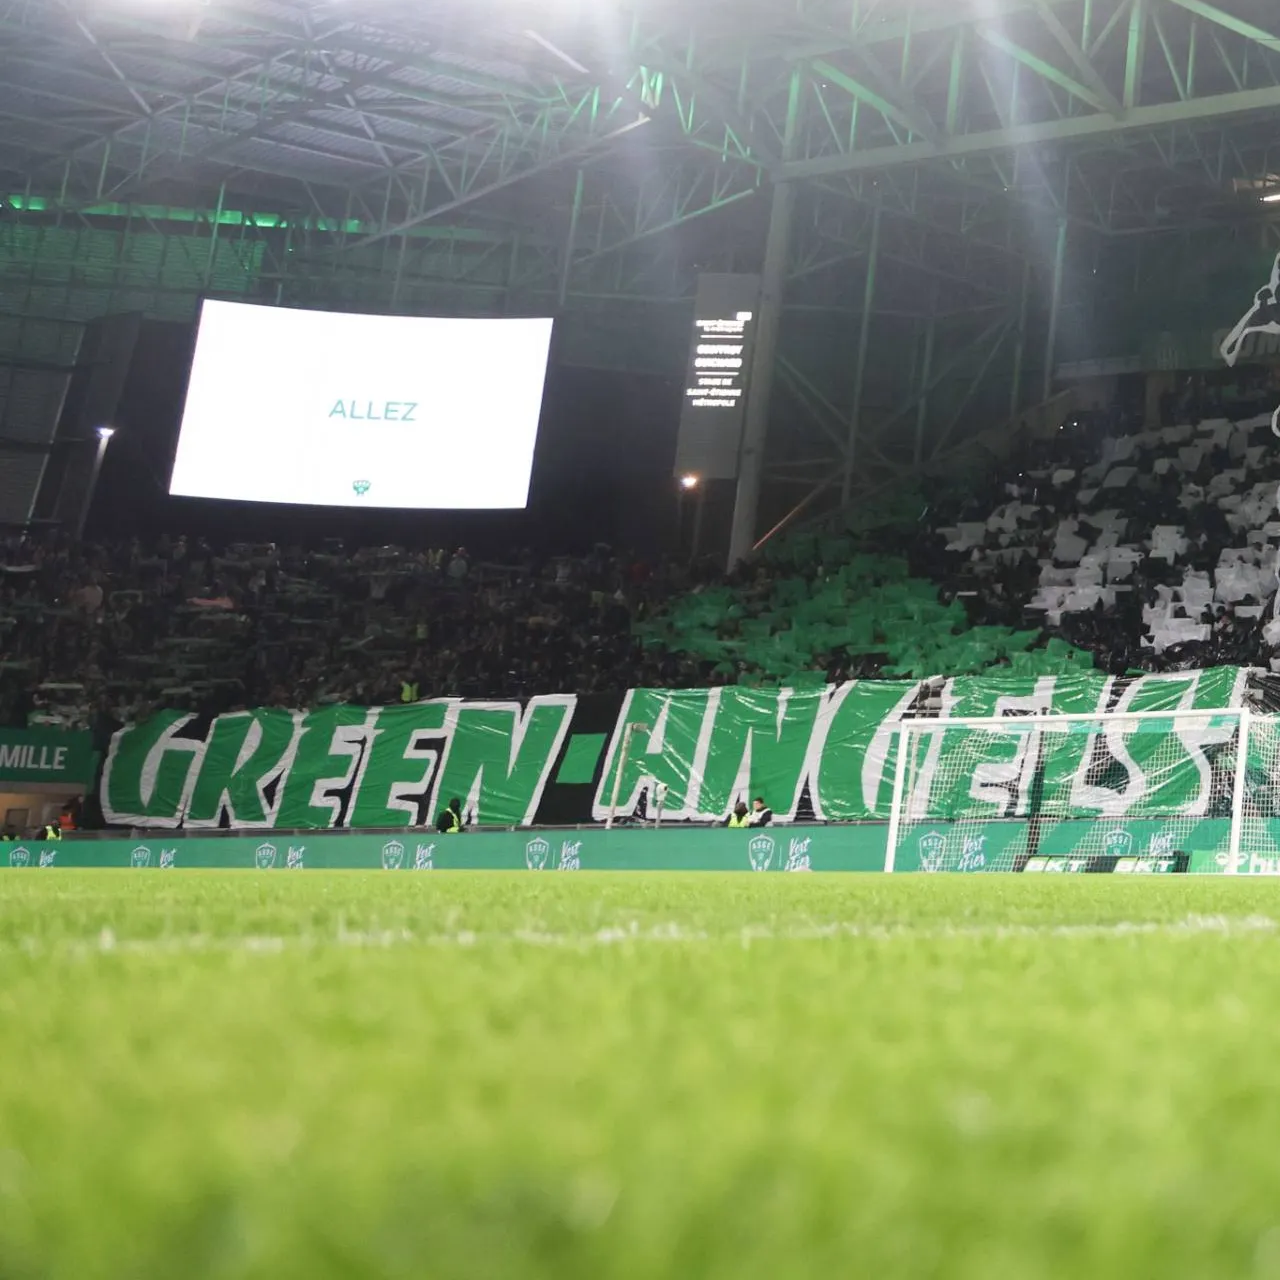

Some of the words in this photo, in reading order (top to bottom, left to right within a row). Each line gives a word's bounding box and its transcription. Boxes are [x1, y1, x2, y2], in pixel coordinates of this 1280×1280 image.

[328, 399, 419, 421] ALLEZ
[1023, 855, 1088, 873] BKT
[1113, 855, 1176, 873] BKT
